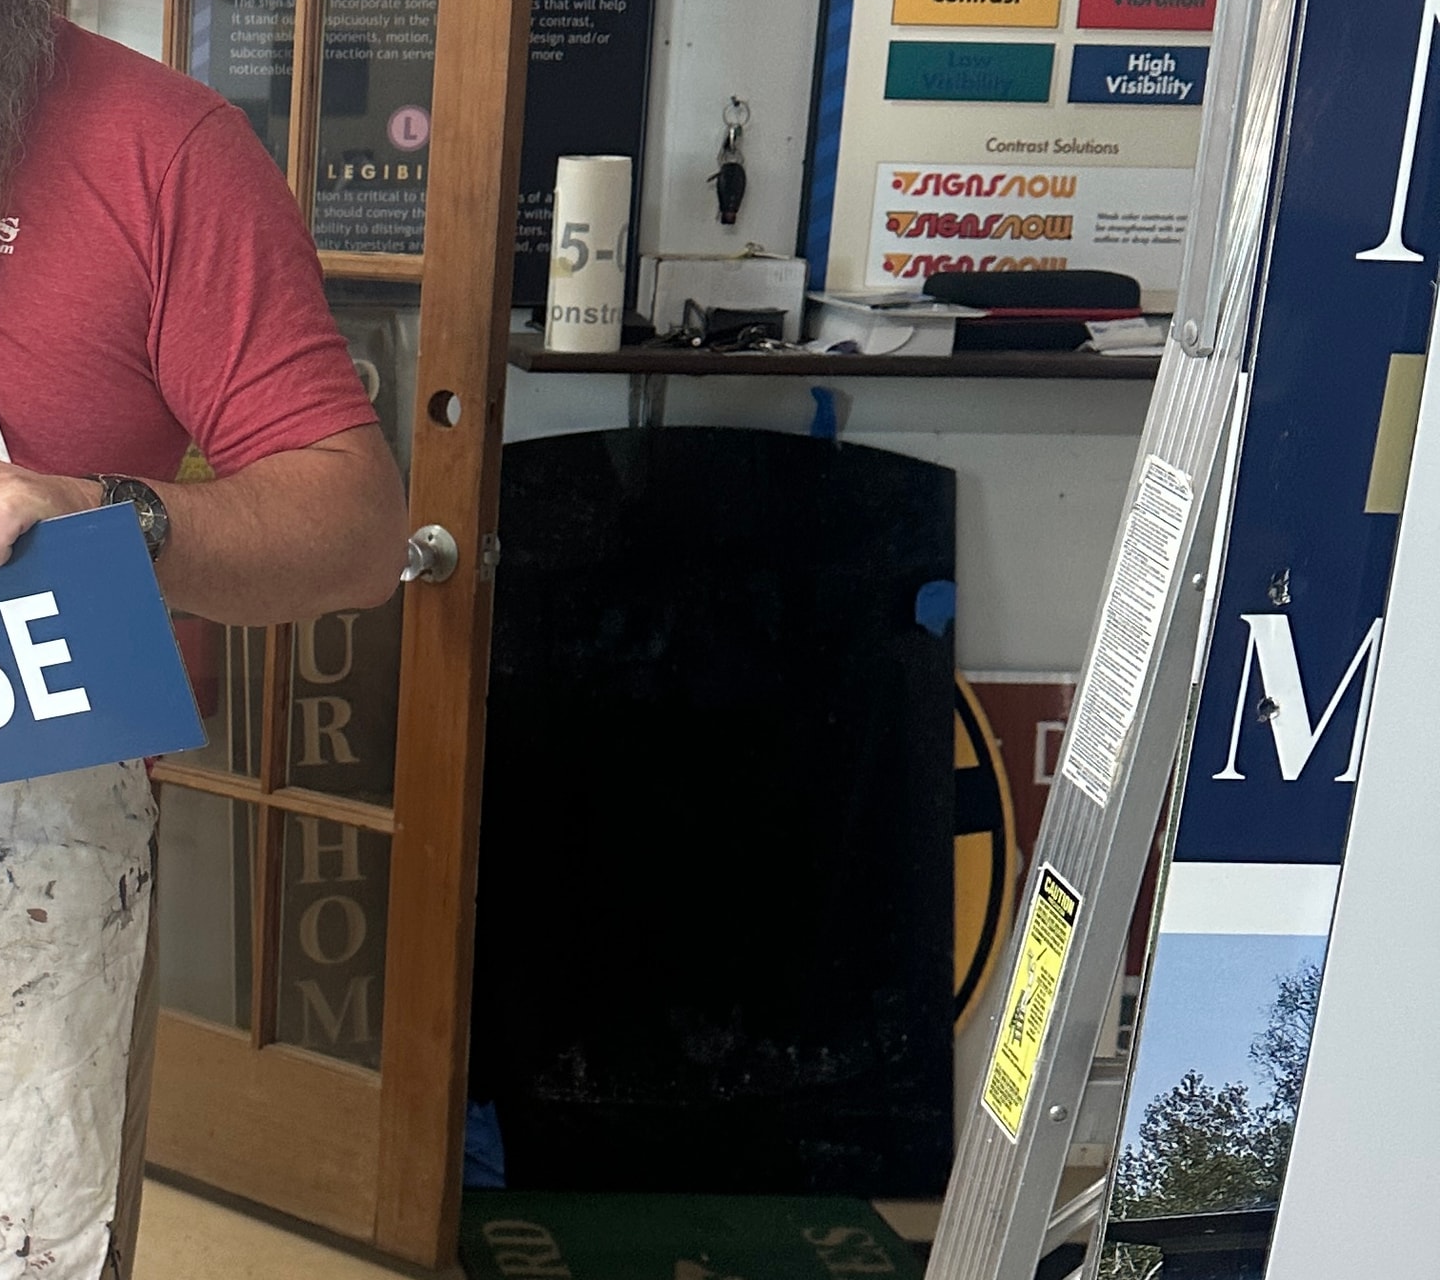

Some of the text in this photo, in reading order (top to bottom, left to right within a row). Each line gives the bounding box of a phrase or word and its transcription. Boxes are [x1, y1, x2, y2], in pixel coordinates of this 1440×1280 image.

[567, 32, 610, 44] and/or
[531, 50, 564, 61] more
[1128, 53, 1176, 77] High
[1105, 75, 1193, 100] Visibility
[403, 116, 418, 140] L
[986, 137, 1119, 156] Contrast Solutions
